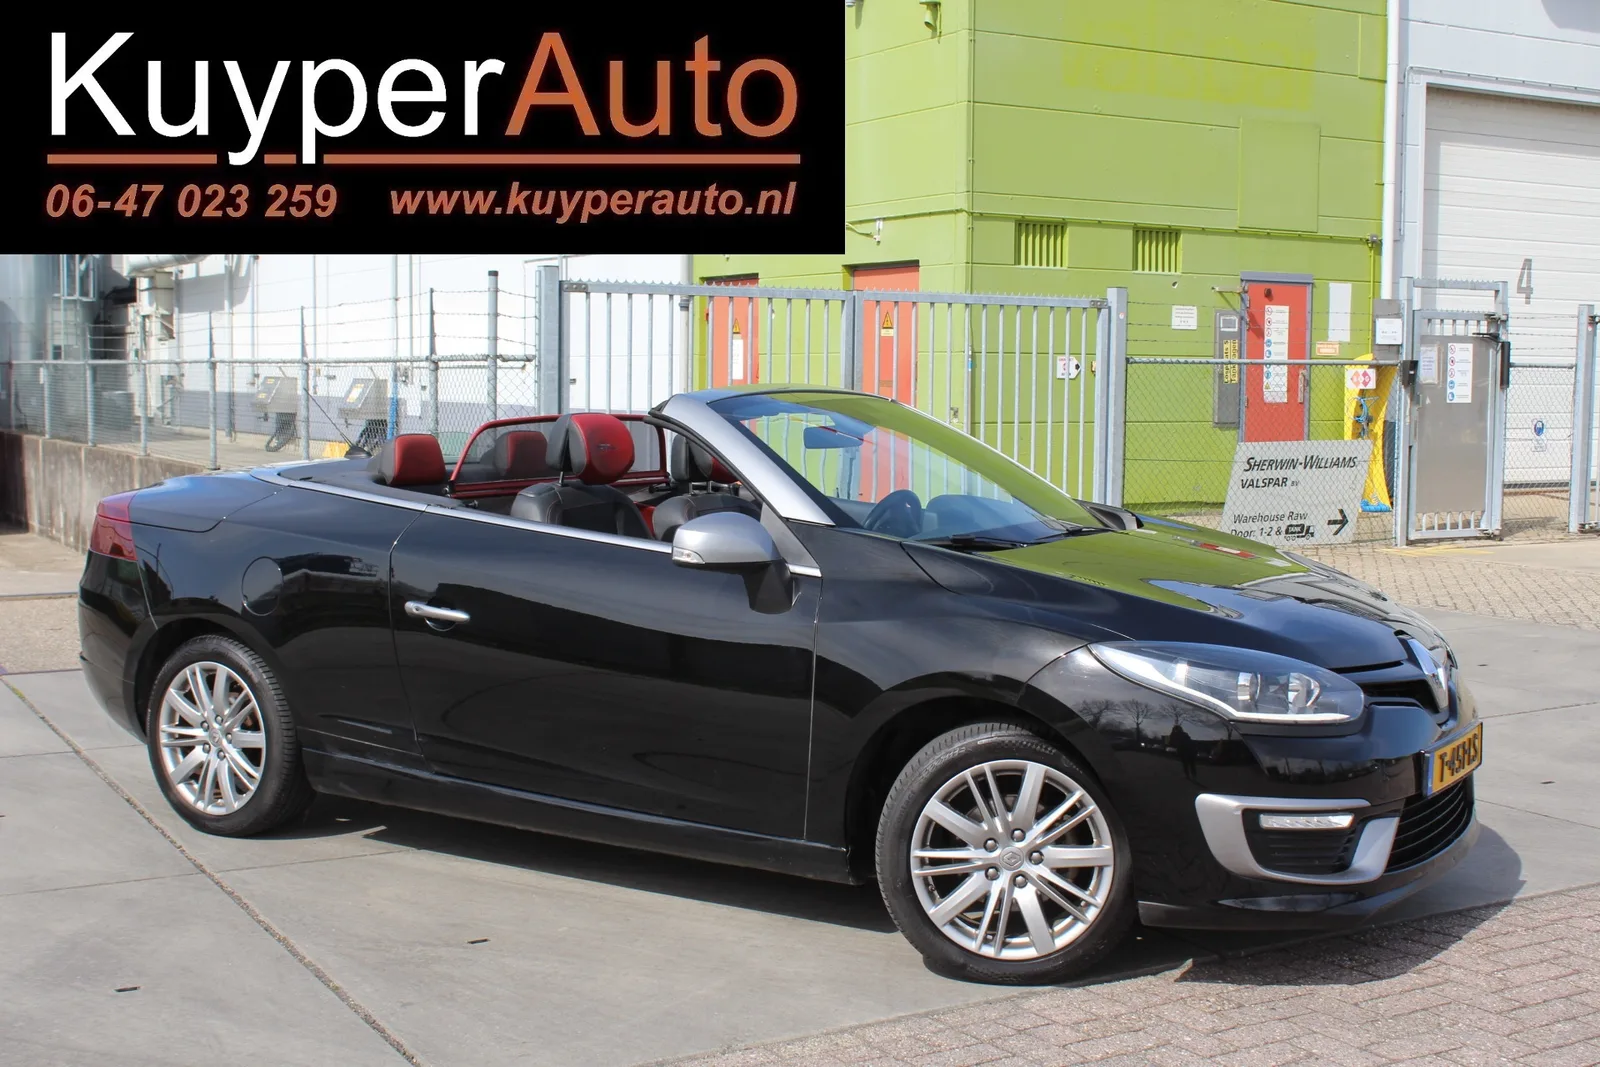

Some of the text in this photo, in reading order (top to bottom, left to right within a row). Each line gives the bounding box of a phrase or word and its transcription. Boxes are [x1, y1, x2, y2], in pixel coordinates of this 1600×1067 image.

[1516, 258, 1534, 305] 4
[1230, 339, 1238, 382] Tankagen
[1241, 477, 1288, 489] VALSPAR
[1233, 511, 1308, 524] Warehouse Raw
[1259, 527, 1273, 537] 1-2
[1275, 526, 1283, 535] &
